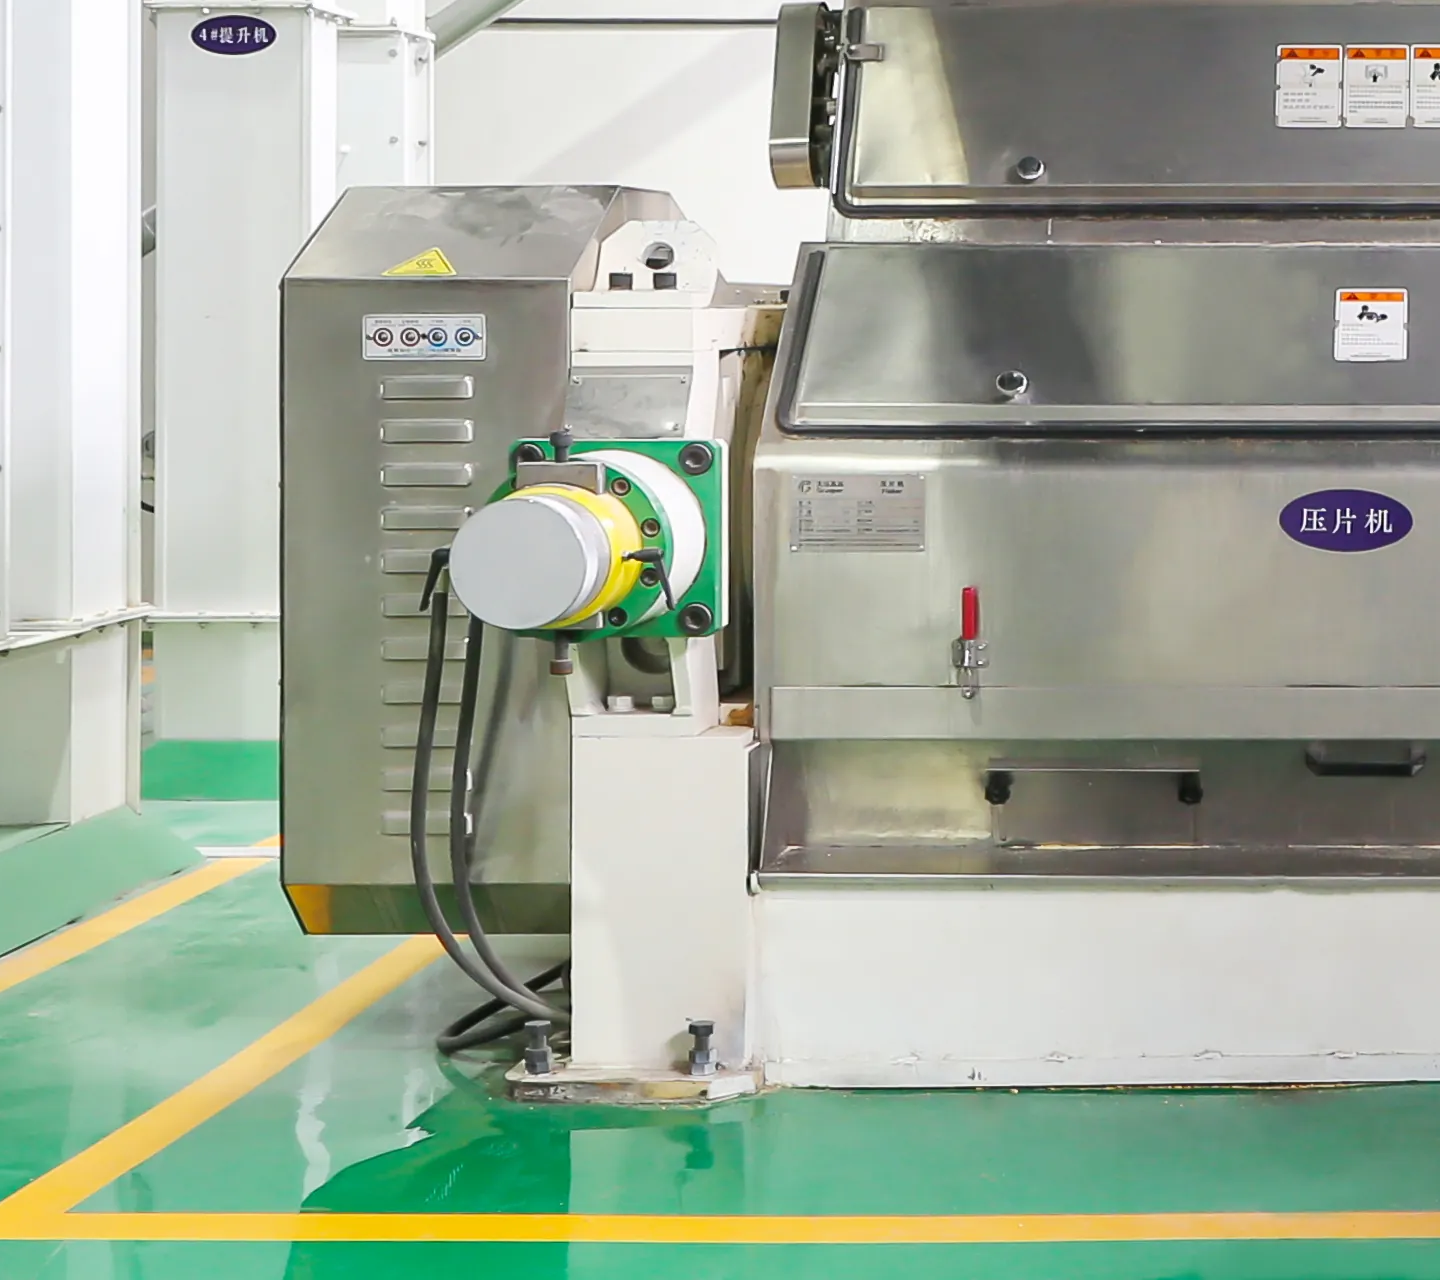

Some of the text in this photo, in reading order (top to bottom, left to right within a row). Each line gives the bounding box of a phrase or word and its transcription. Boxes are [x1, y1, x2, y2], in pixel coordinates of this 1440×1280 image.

[199, 26, 269, 44] 4#提升机
[1299, 507, 1394, 535] 压片机
